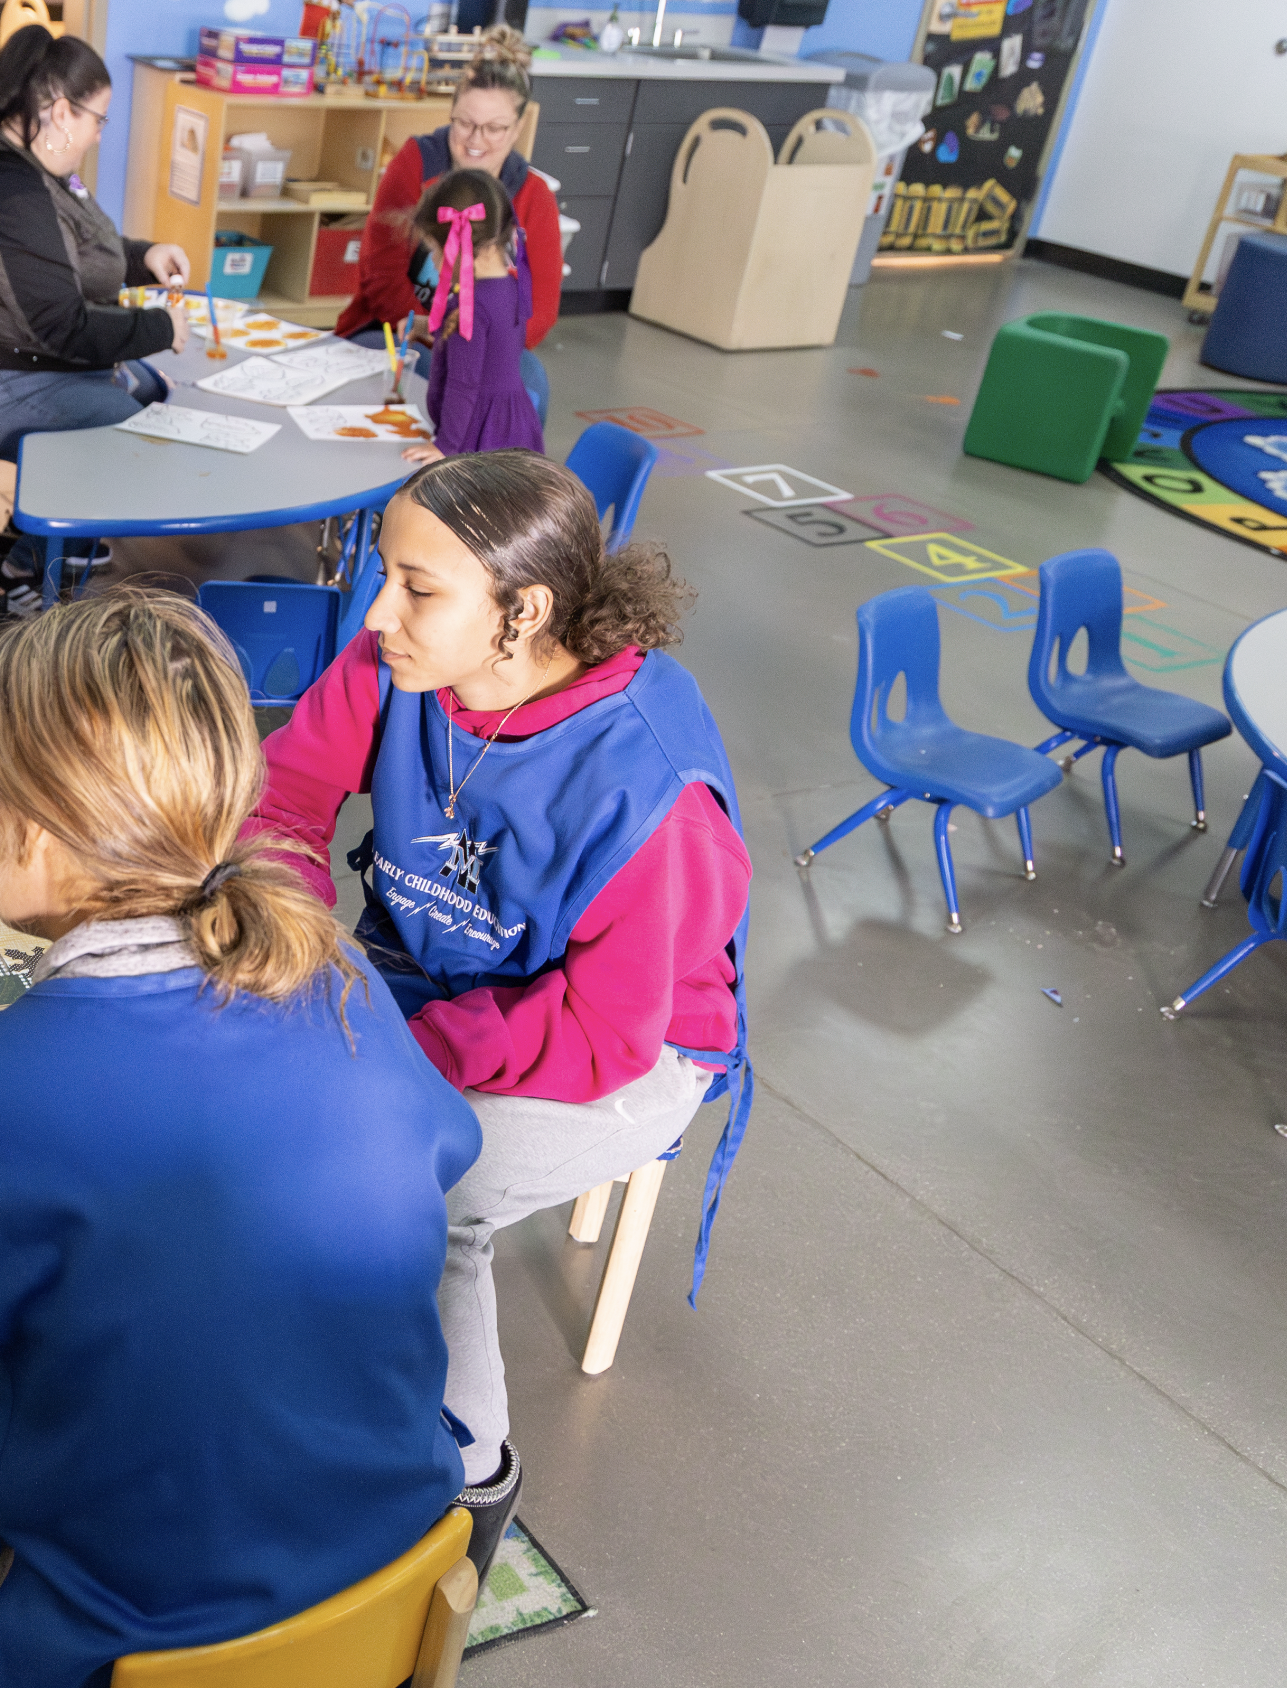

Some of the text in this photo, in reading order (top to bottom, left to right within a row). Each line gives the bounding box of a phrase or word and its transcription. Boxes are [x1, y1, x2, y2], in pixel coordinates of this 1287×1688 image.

[742, 472, 796, 498] 7
[785, 511, 847, 537] 5
[926, 543, 991, 570] 4
[374, 850, 527, 939] EARLY CHILDHOOD EDUCATION
[385, 886, 501, 951] Engage Create Encourage
